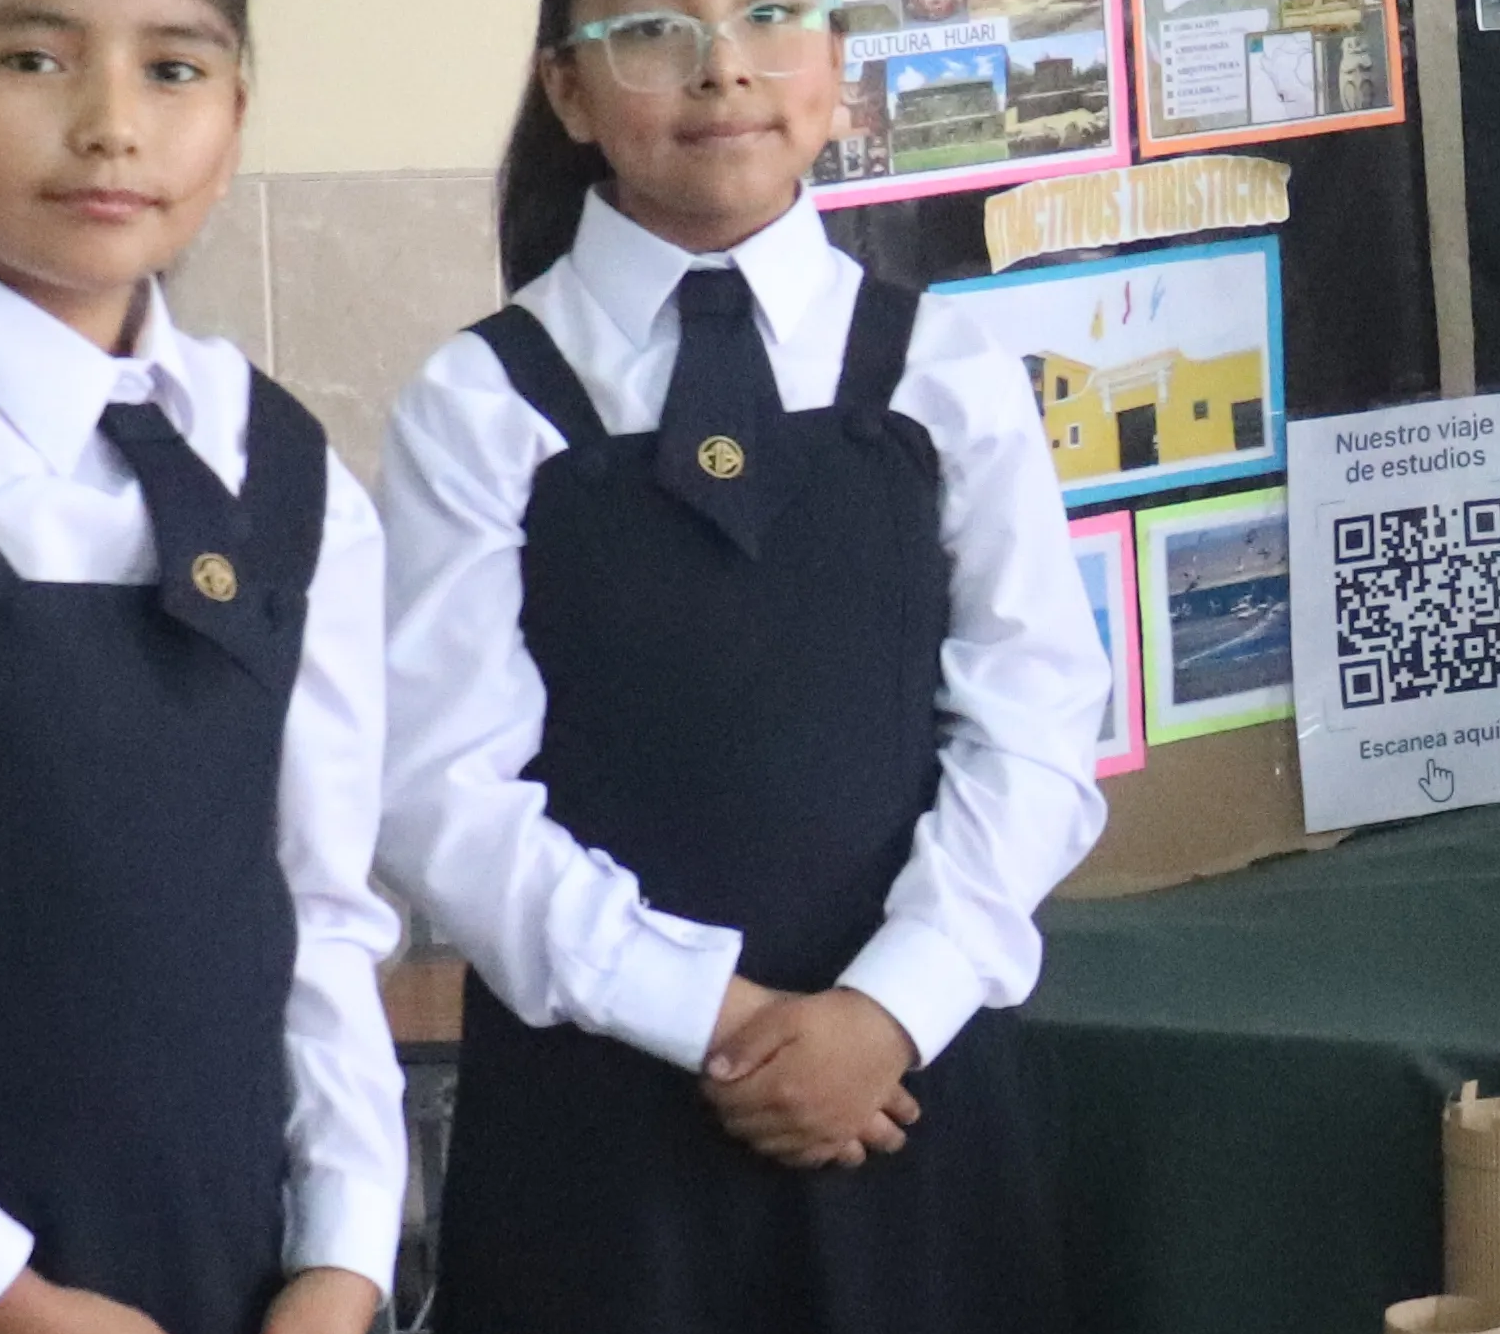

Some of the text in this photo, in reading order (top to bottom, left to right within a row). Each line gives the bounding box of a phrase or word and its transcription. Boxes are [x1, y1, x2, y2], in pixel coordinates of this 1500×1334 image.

[851, 24, 996, 58] CULTURA HUARI
[1336, 413, 1494, 454] Nuestro viaje
[1346, 446, 1487, 484] de estudios
[1360, 719, 1500, 759] Escanea aquí
